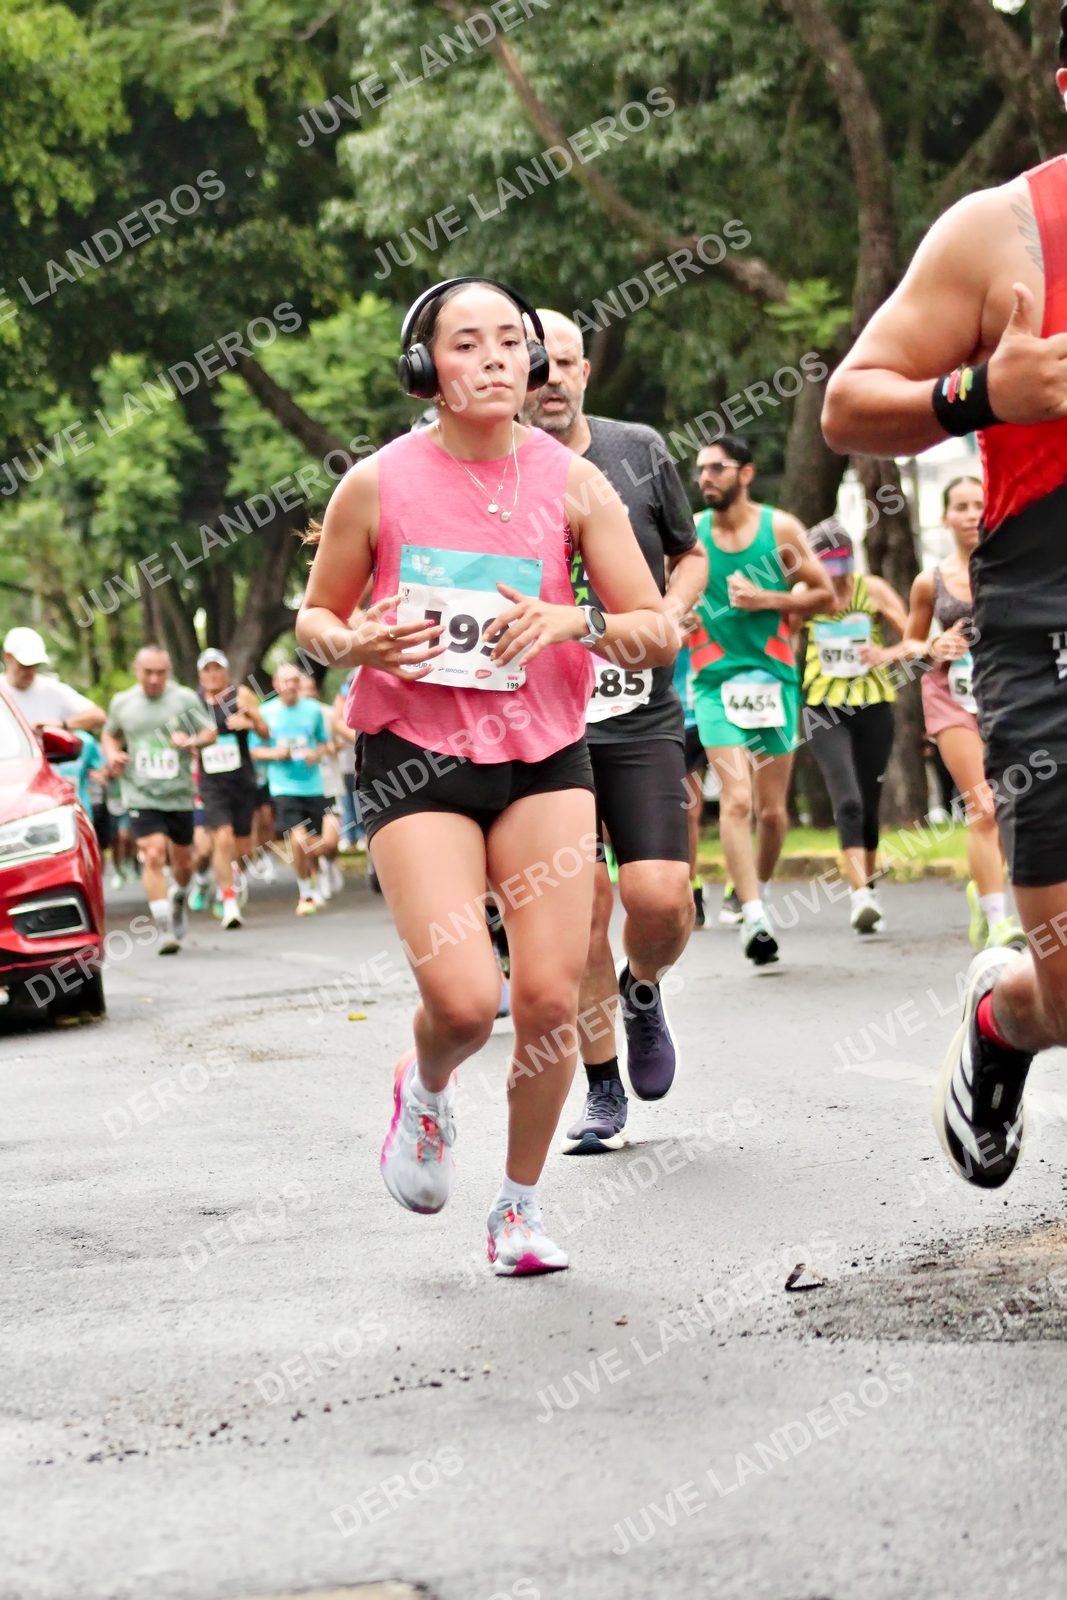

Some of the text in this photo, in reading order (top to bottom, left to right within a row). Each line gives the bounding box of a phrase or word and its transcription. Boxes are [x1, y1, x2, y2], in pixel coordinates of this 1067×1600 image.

[822, 648, 860, 663] 676
[506, 682, 519, 690] 199
[729, 695, 776, 711] 4454
